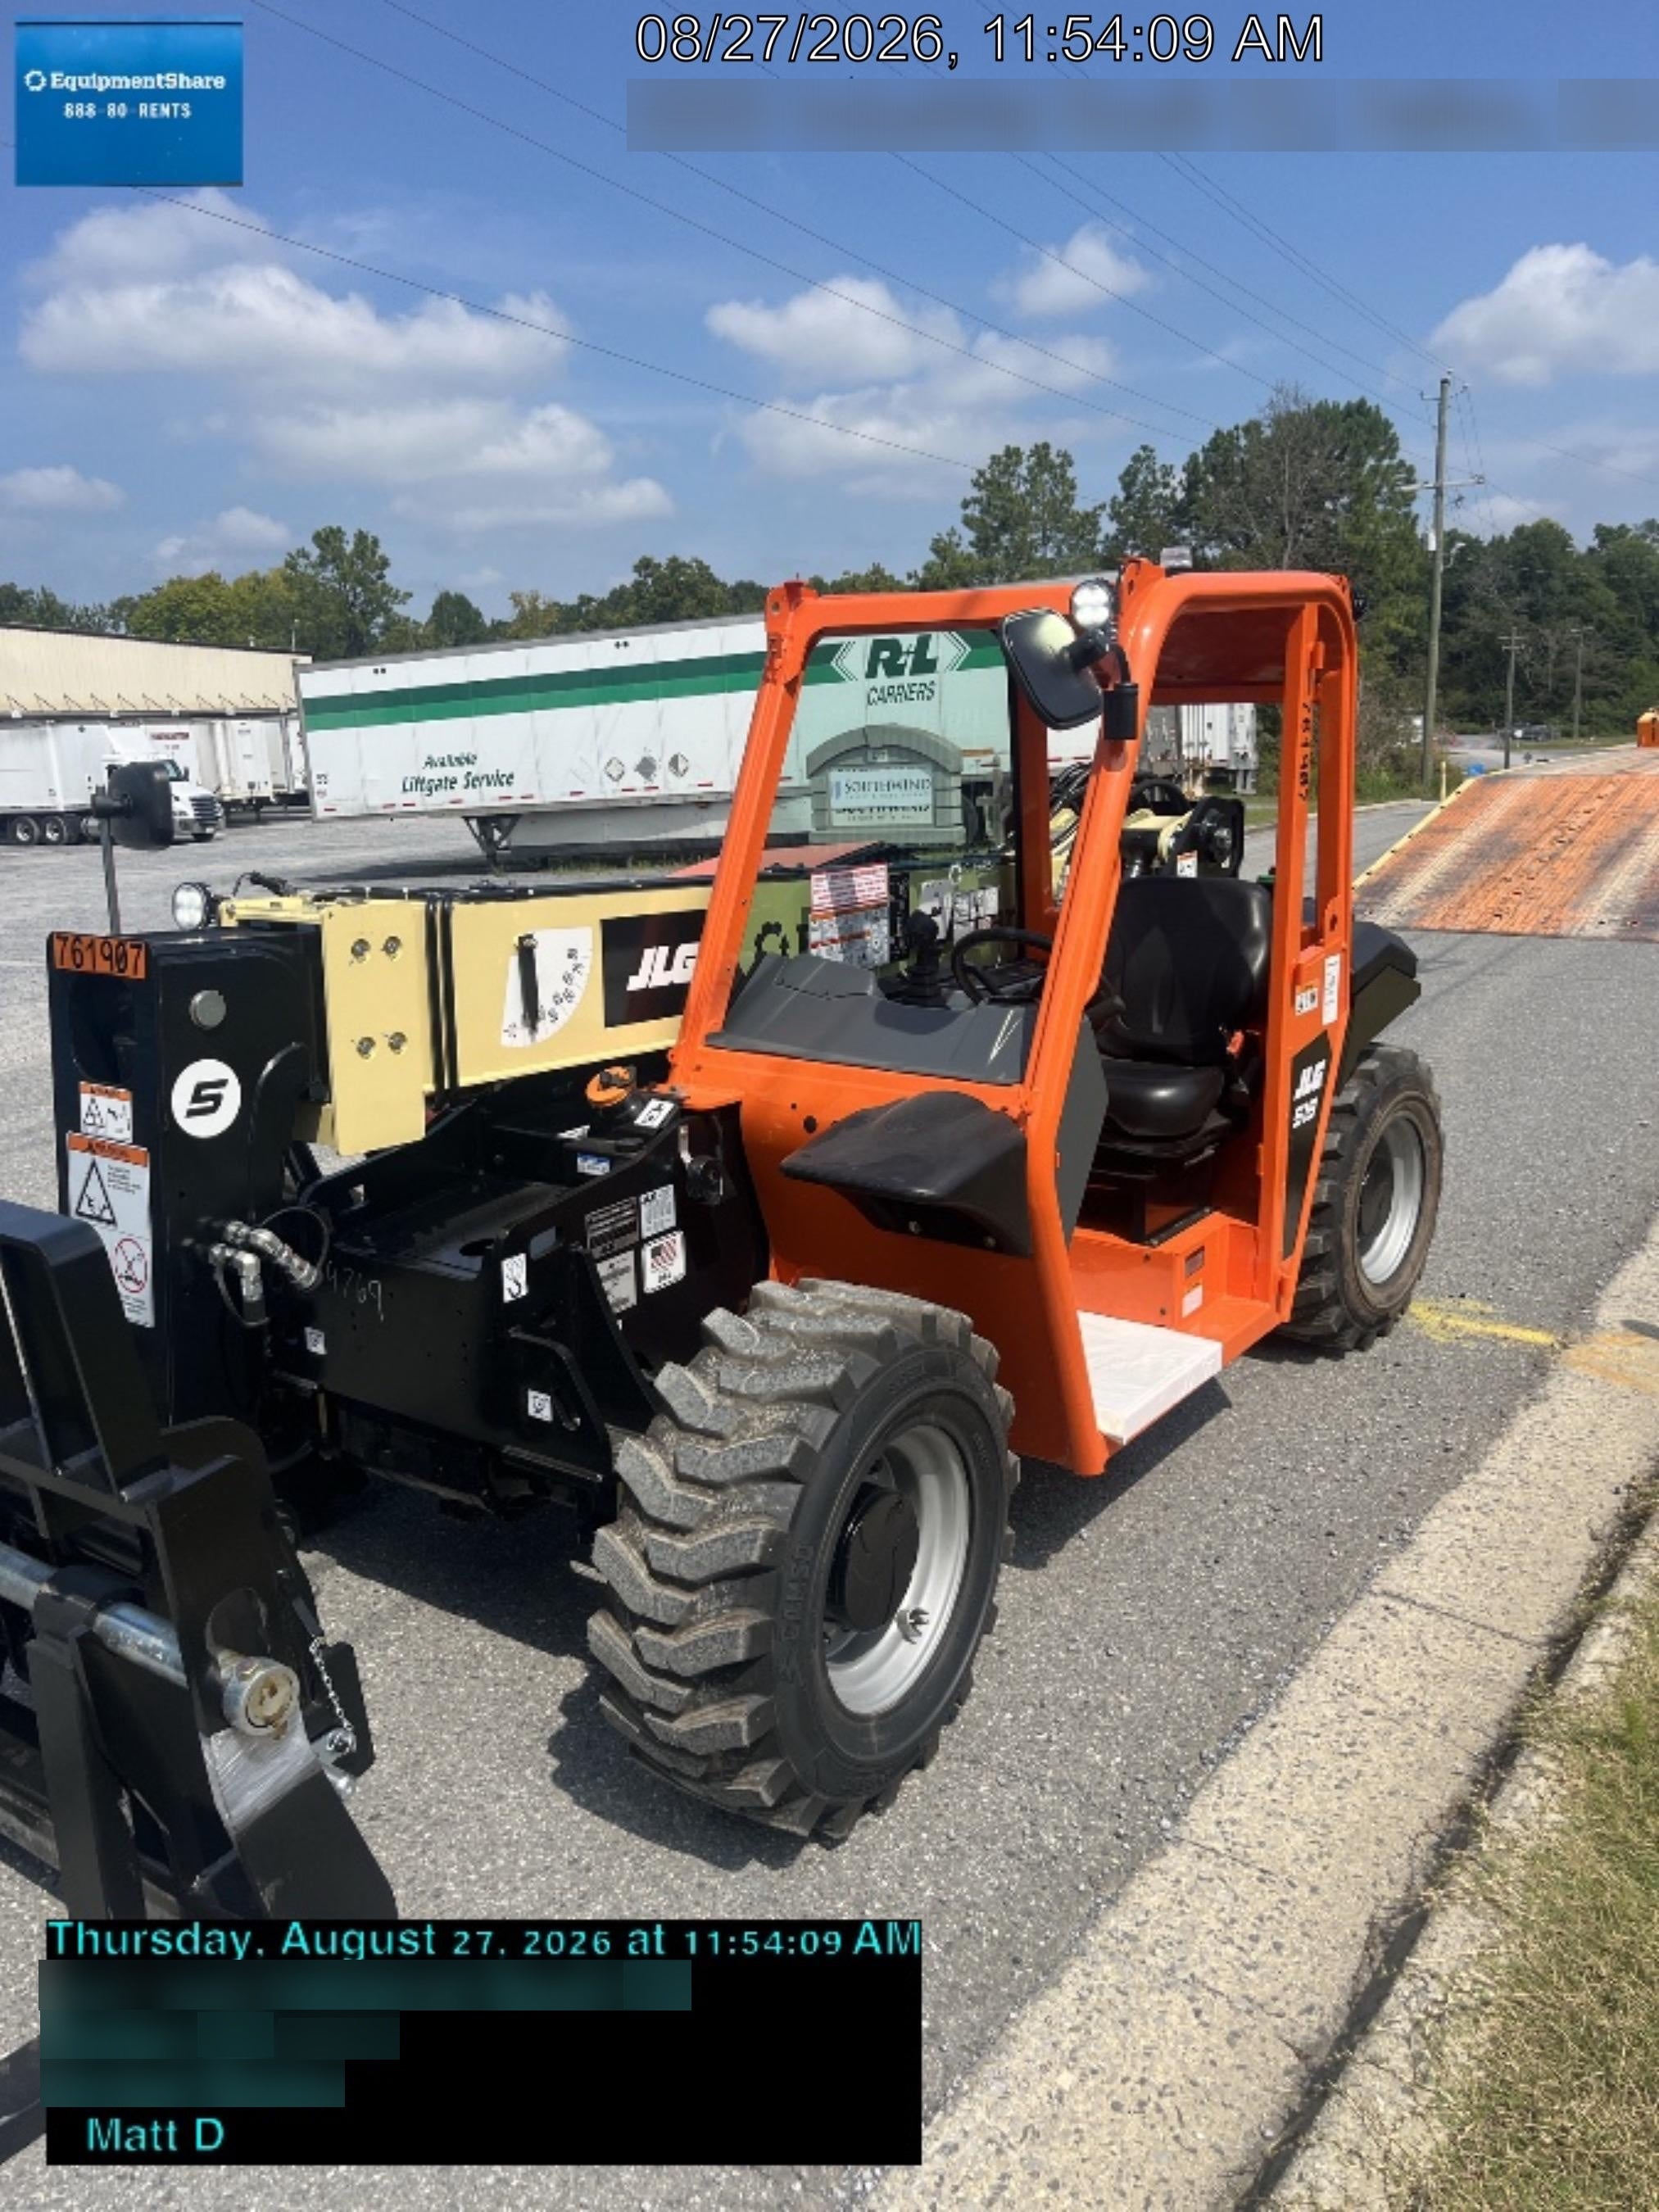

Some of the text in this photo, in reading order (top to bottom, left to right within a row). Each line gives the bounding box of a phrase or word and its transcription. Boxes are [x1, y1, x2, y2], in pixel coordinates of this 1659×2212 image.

[50, 71, 226, 92] EquipmentShare
[401, 768, 514, 797] Liftgate Service
[55, 935, 143, 976] 761907
[626, 941, 701, 992] JLG
